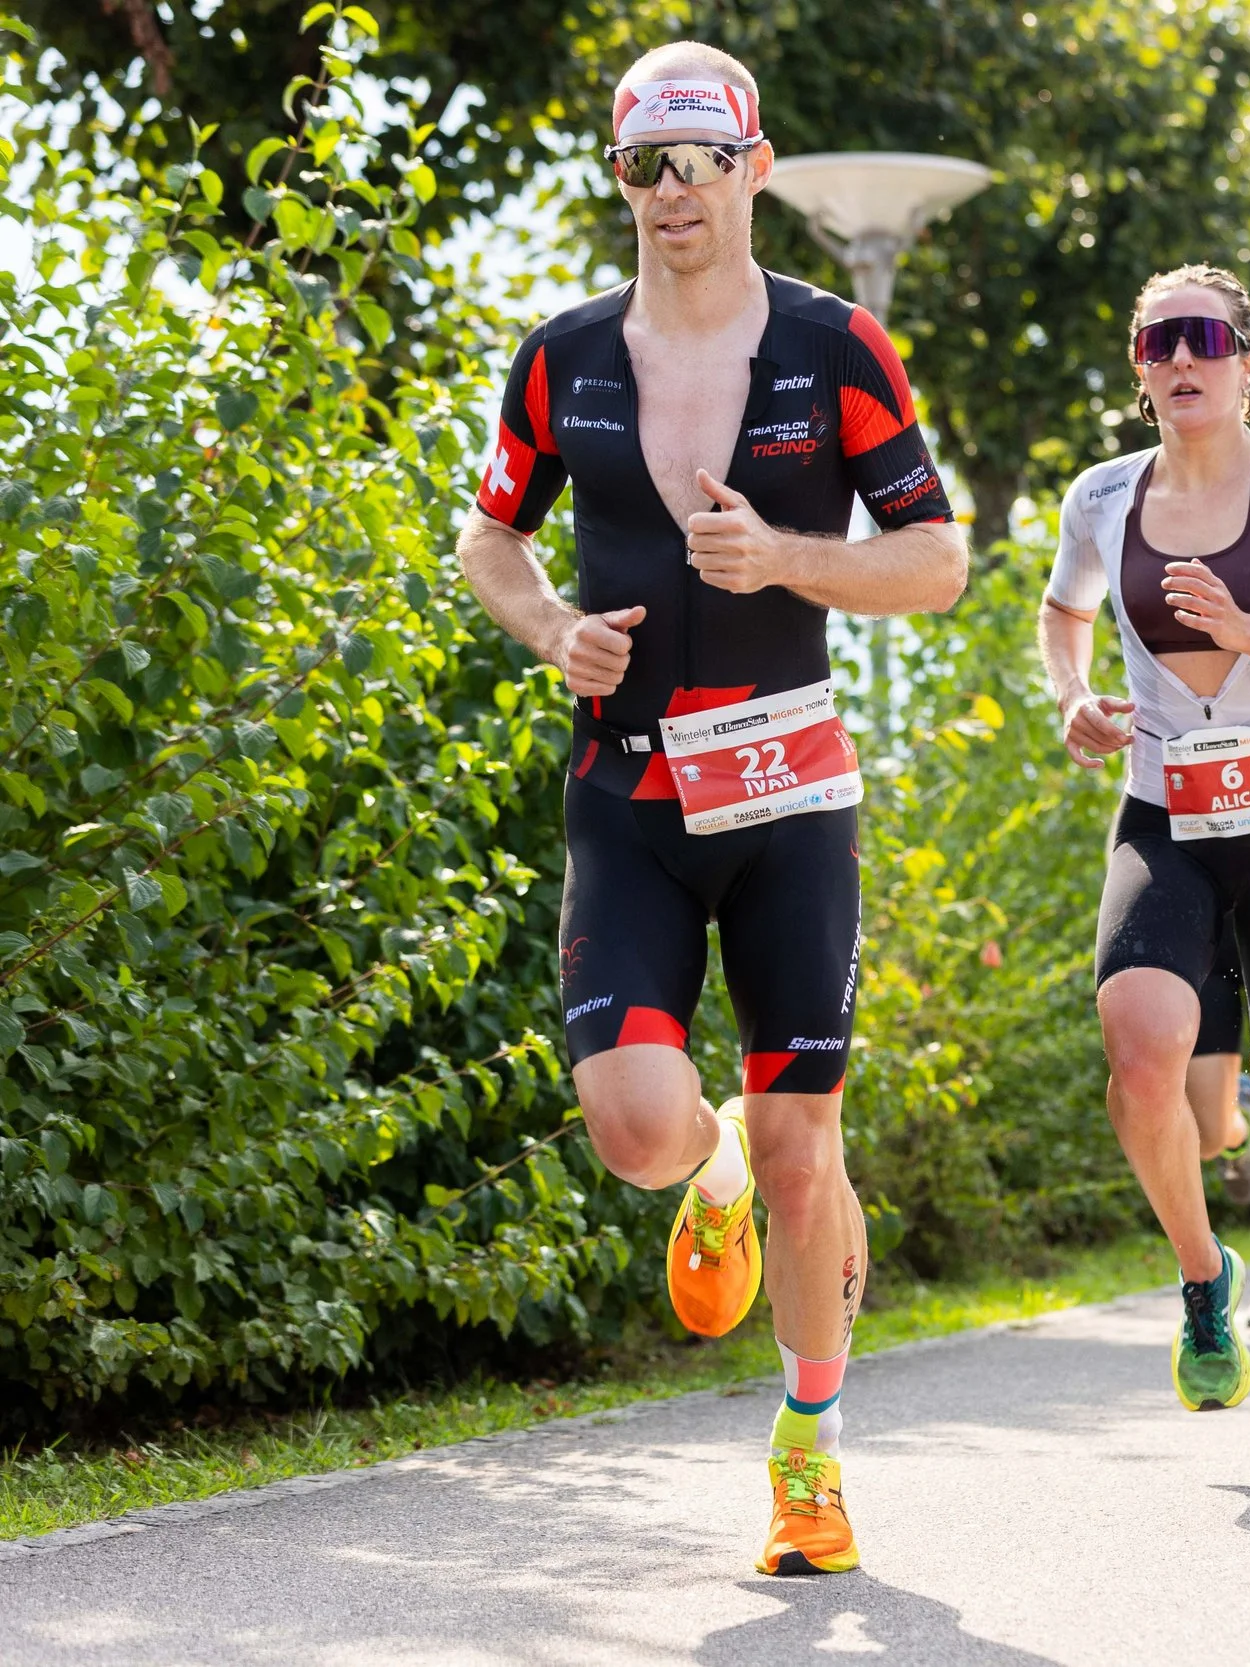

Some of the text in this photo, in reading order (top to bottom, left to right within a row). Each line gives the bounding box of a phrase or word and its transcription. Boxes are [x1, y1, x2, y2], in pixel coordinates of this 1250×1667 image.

[661, 90, 721, 100] TICINO
[668, 105, 727, 114] TRIATHLON
[583, 379, 622, 390] PREZIOSI
[772, 374, 815, 391] antini
[570, 416, 625, 432] BancaStato
[747, 421, 809, 437] TRIATHLON
[776, 431, 808, 441] TEAM
[752, 440, 817, 458] TICINO
[868, 465, 925, 500] TRIATHLON
[902, 472, 928, 493] TEAM
[1089, 480, 1129, 501] FUSION
[881, 476, 938, 515] TICINO
[671, 698, 829, 742] Winteler BancaStato MIGROS TICINO
[735, 741, 789, 778] 22
[744, 771, 798, 797] IVAN
[1221, 761, 1244, 790] 6
[740, 807, 771, 819] ASCONA
[775, 796, 809, 814] unicef
[694, 815, 724, 828] groupe
[735, 812, 772, 824] LOCARNO
[566, 993, 615, 1025] Santini
[787, 1037, 845, 1050] Santini
